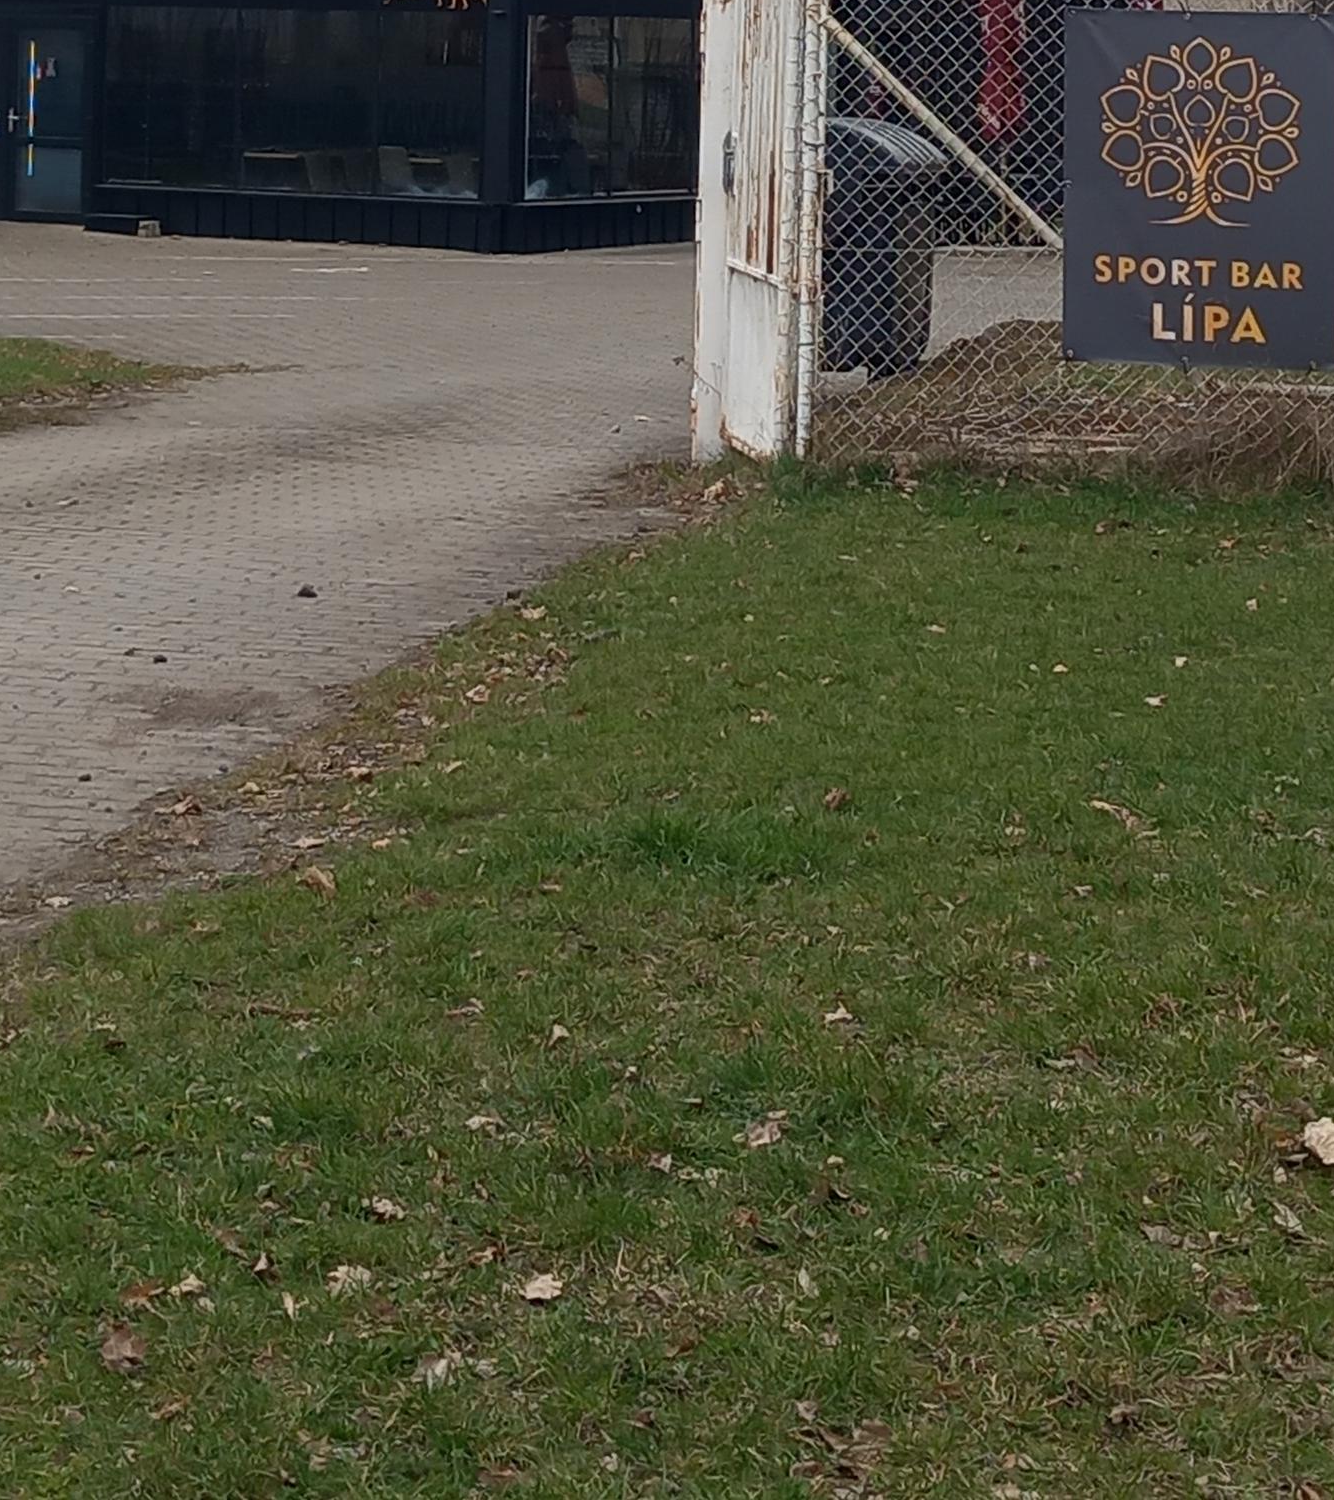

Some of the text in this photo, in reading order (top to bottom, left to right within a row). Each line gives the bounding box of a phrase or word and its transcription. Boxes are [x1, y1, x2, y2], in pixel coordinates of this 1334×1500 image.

[1094, 255, 1304, 290] SPORT BAR
[1151, 293, 1267, 344] LÍPA
